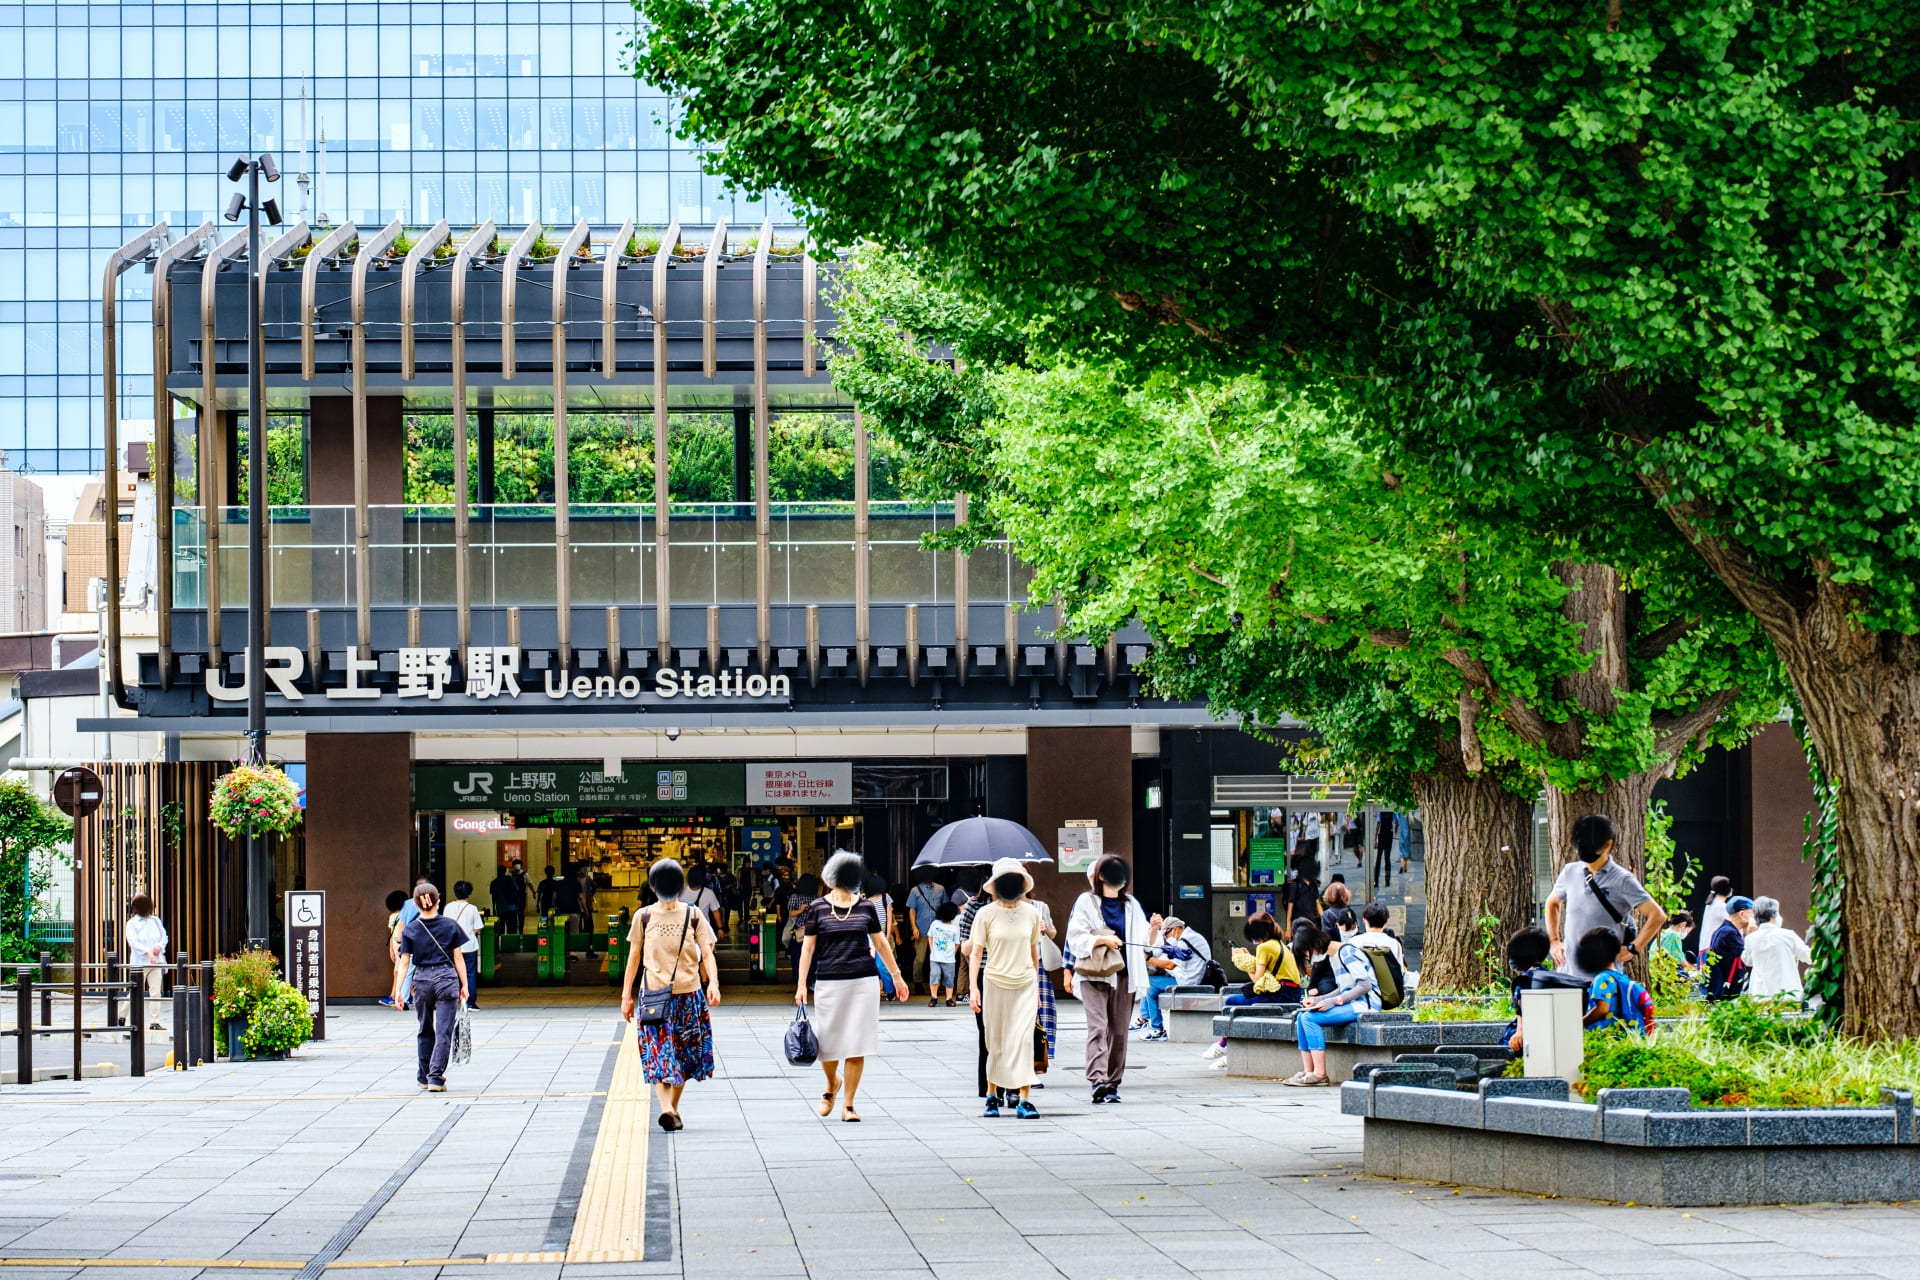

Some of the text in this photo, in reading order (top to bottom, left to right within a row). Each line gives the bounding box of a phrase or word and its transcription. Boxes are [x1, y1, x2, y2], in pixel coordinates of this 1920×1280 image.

[544, 669, 640, 699] Ueno
[655, 668, 790, 698] Station
[453, 772, 493, 794] JR
[504, 772, 556, 789] 上野駅
[504, 792, 570, 802] Ueno Station
[765, 790, 831, 798] には乗れません。
[454, 818, 487, 833] Gong
[539, 937, 547, 946] IC
[609, 937, 618, 946] IC
